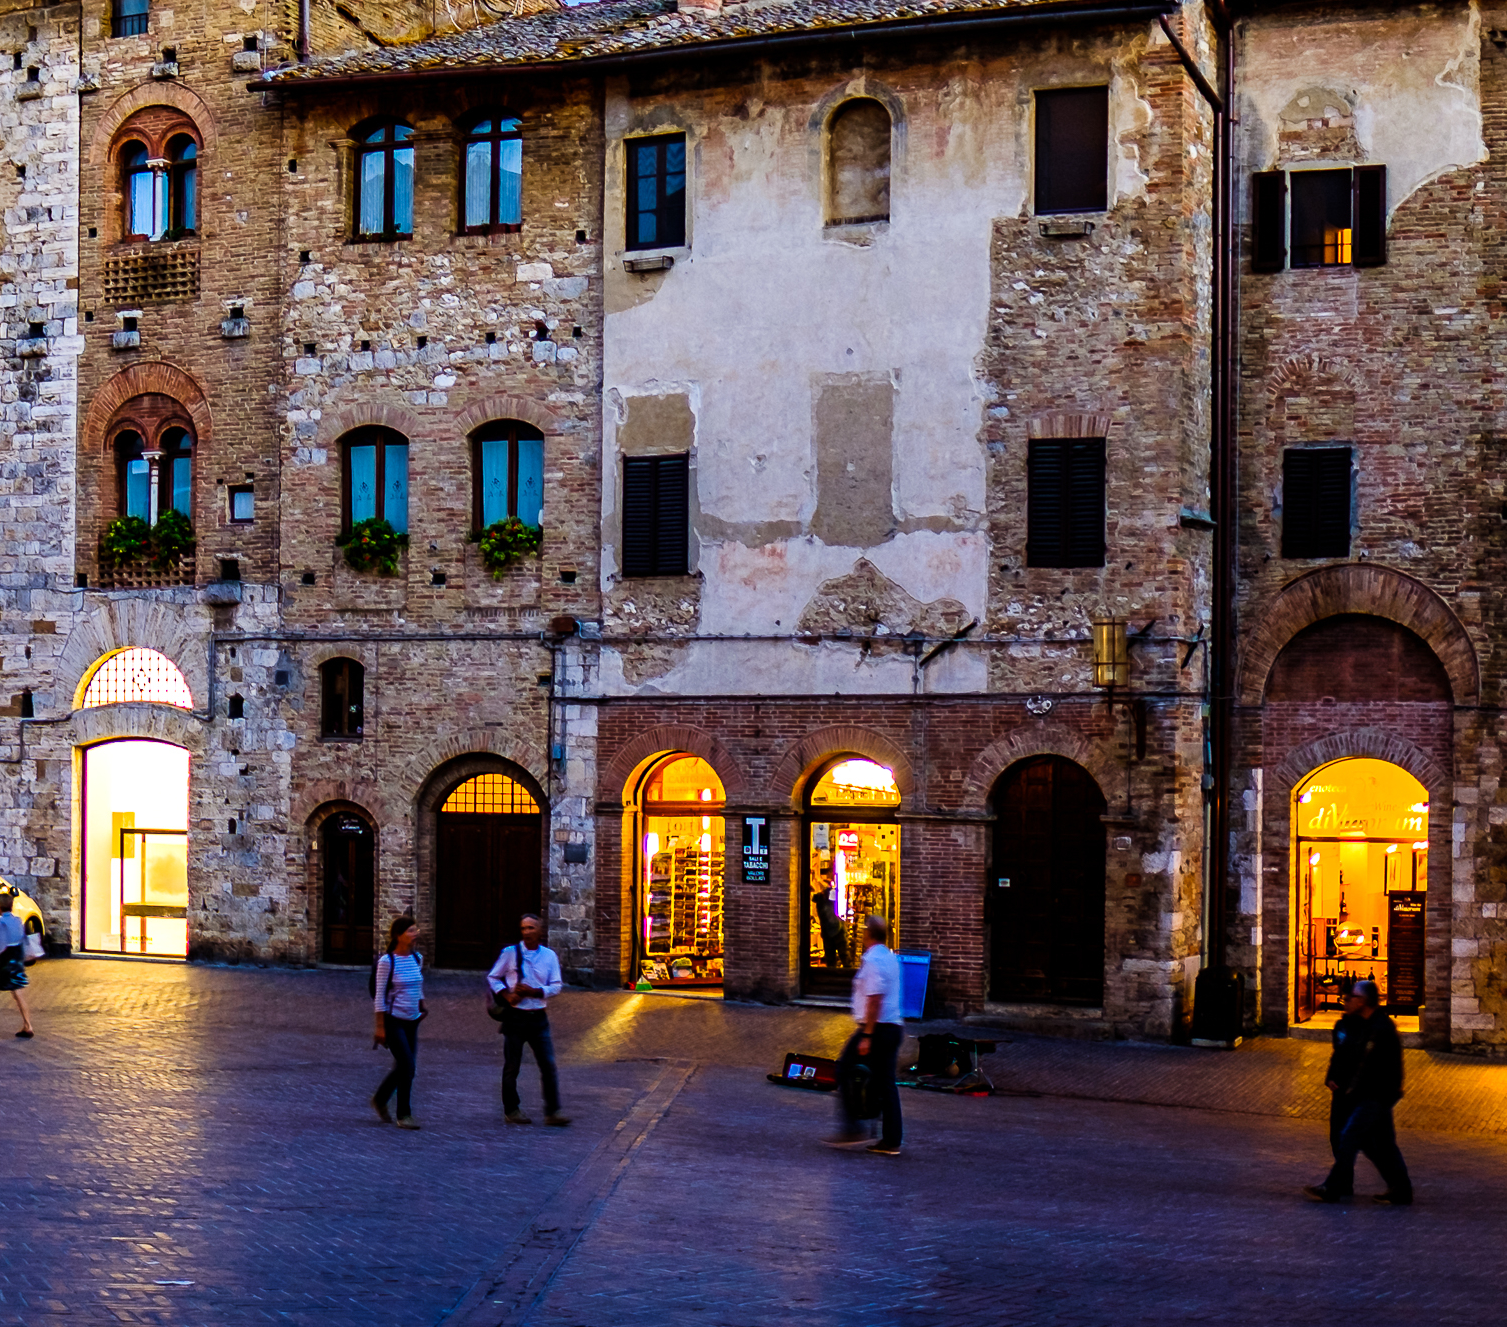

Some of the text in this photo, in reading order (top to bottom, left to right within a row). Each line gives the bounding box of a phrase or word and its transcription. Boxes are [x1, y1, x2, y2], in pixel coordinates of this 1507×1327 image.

[1309, 784, 1347, 793] enoteca
[745, 817, 766, 854] T
[743, 861, 769, 869] TABACCHI
